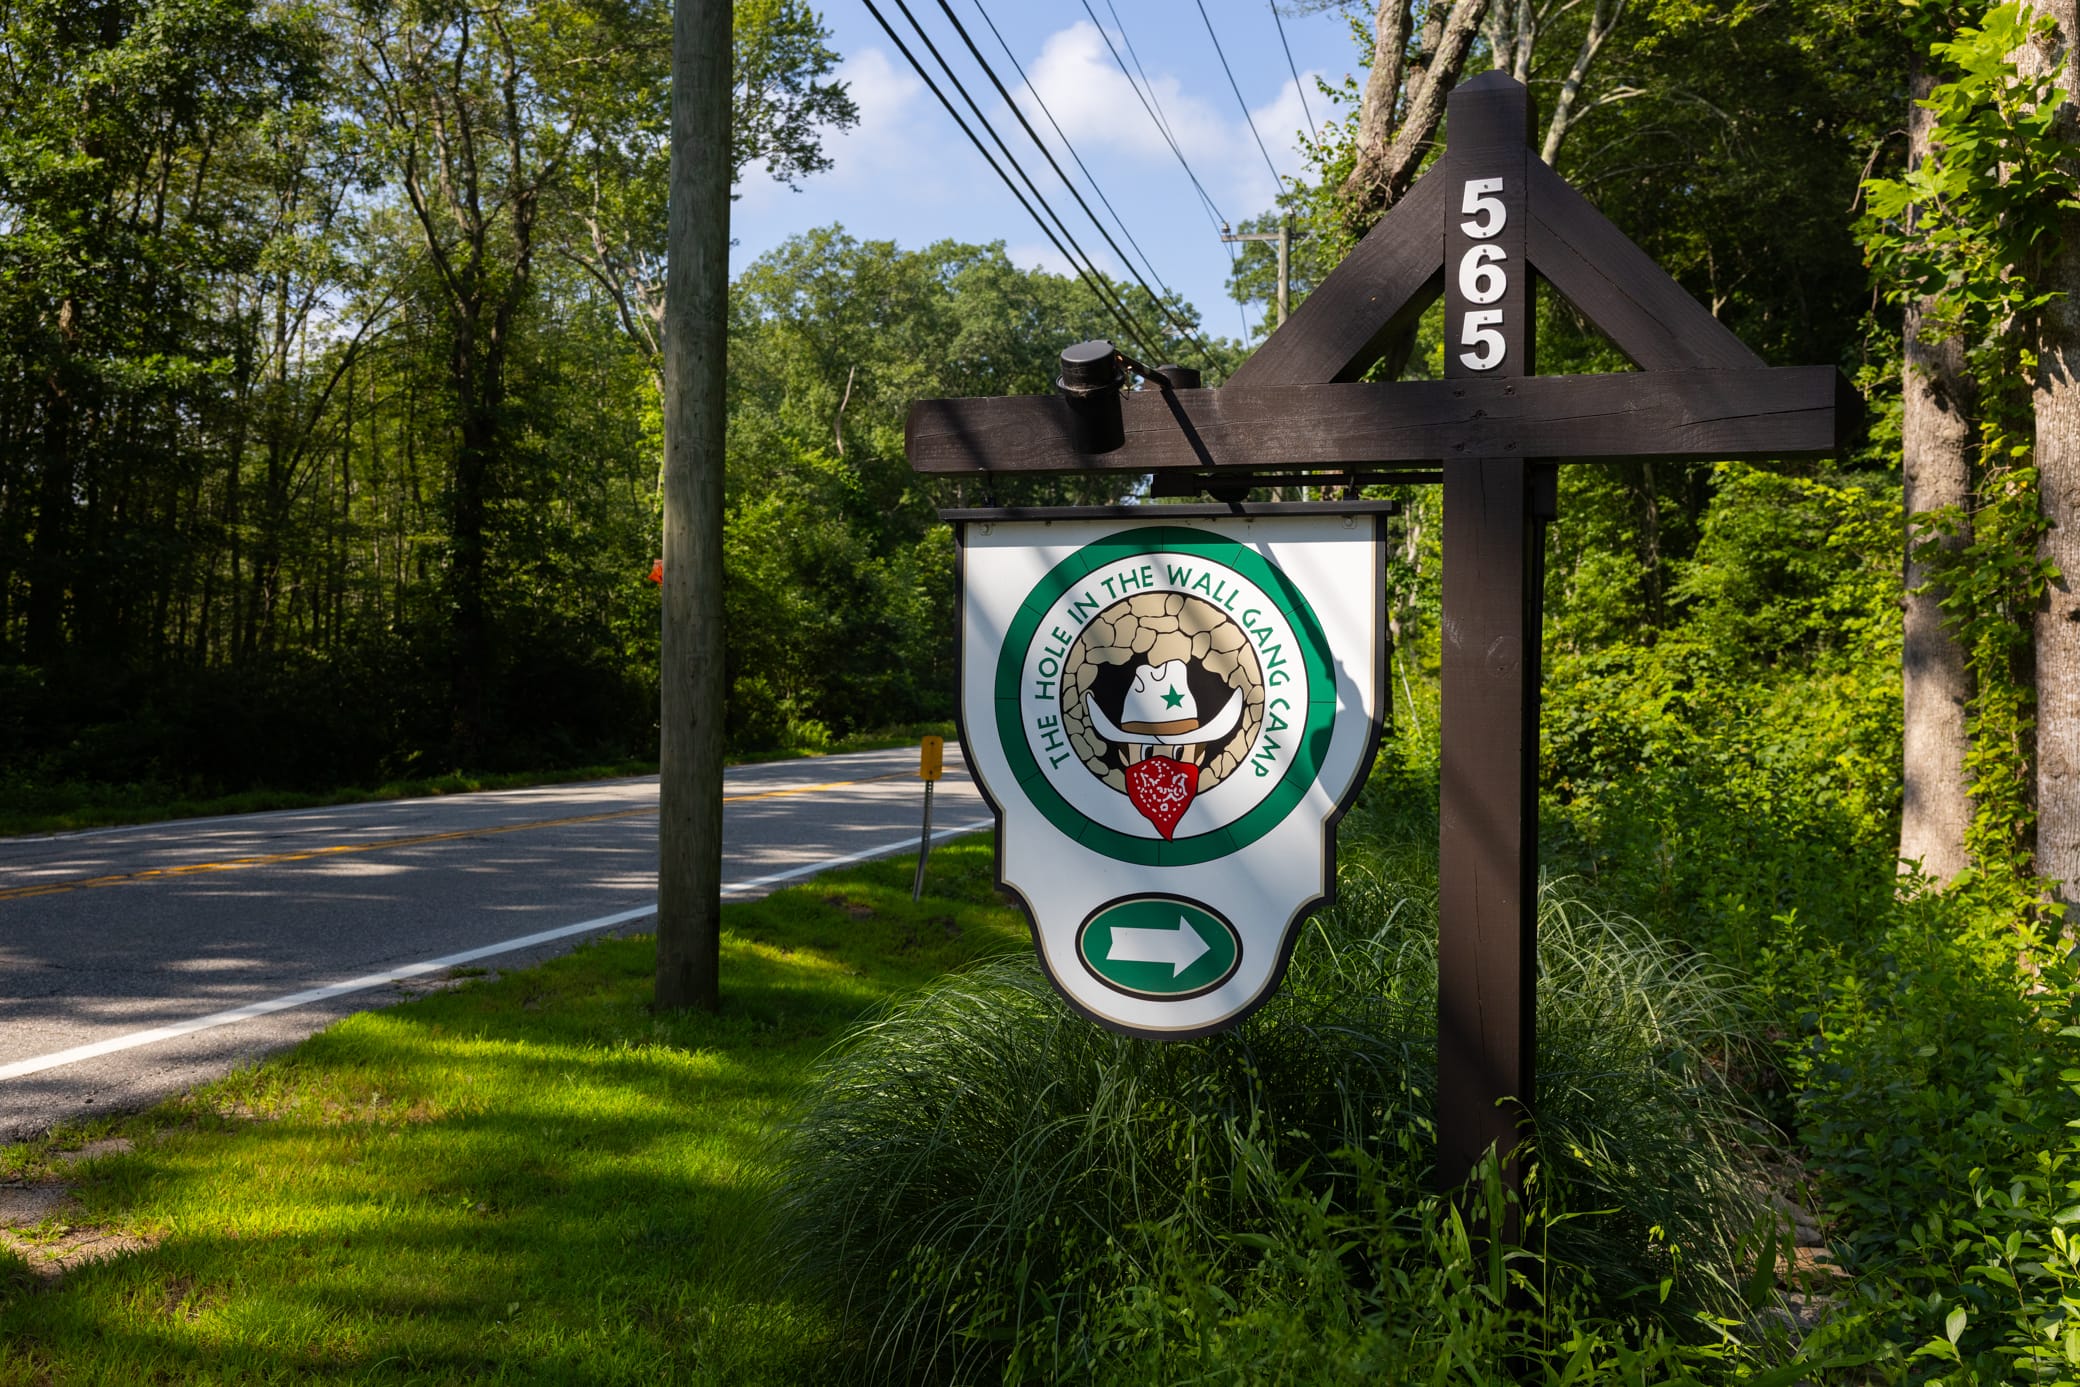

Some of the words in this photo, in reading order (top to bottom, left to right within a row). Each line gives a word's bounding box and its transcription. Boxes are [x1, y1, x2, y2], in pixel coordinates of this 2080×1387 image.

[1458, 177, 1508, 371] 565
[1067, 591, 1100, 627] IN
[1101, 565, 1154, 600] THE
[1166, 564, 1241, 612] WALL
[1035, 626, 1073, 700] HOLE
[1241, 608, 1291, 687] GANG
[1037, 714, 1071, 770] THE
[1253, 698, 1291, 778] CAMP
